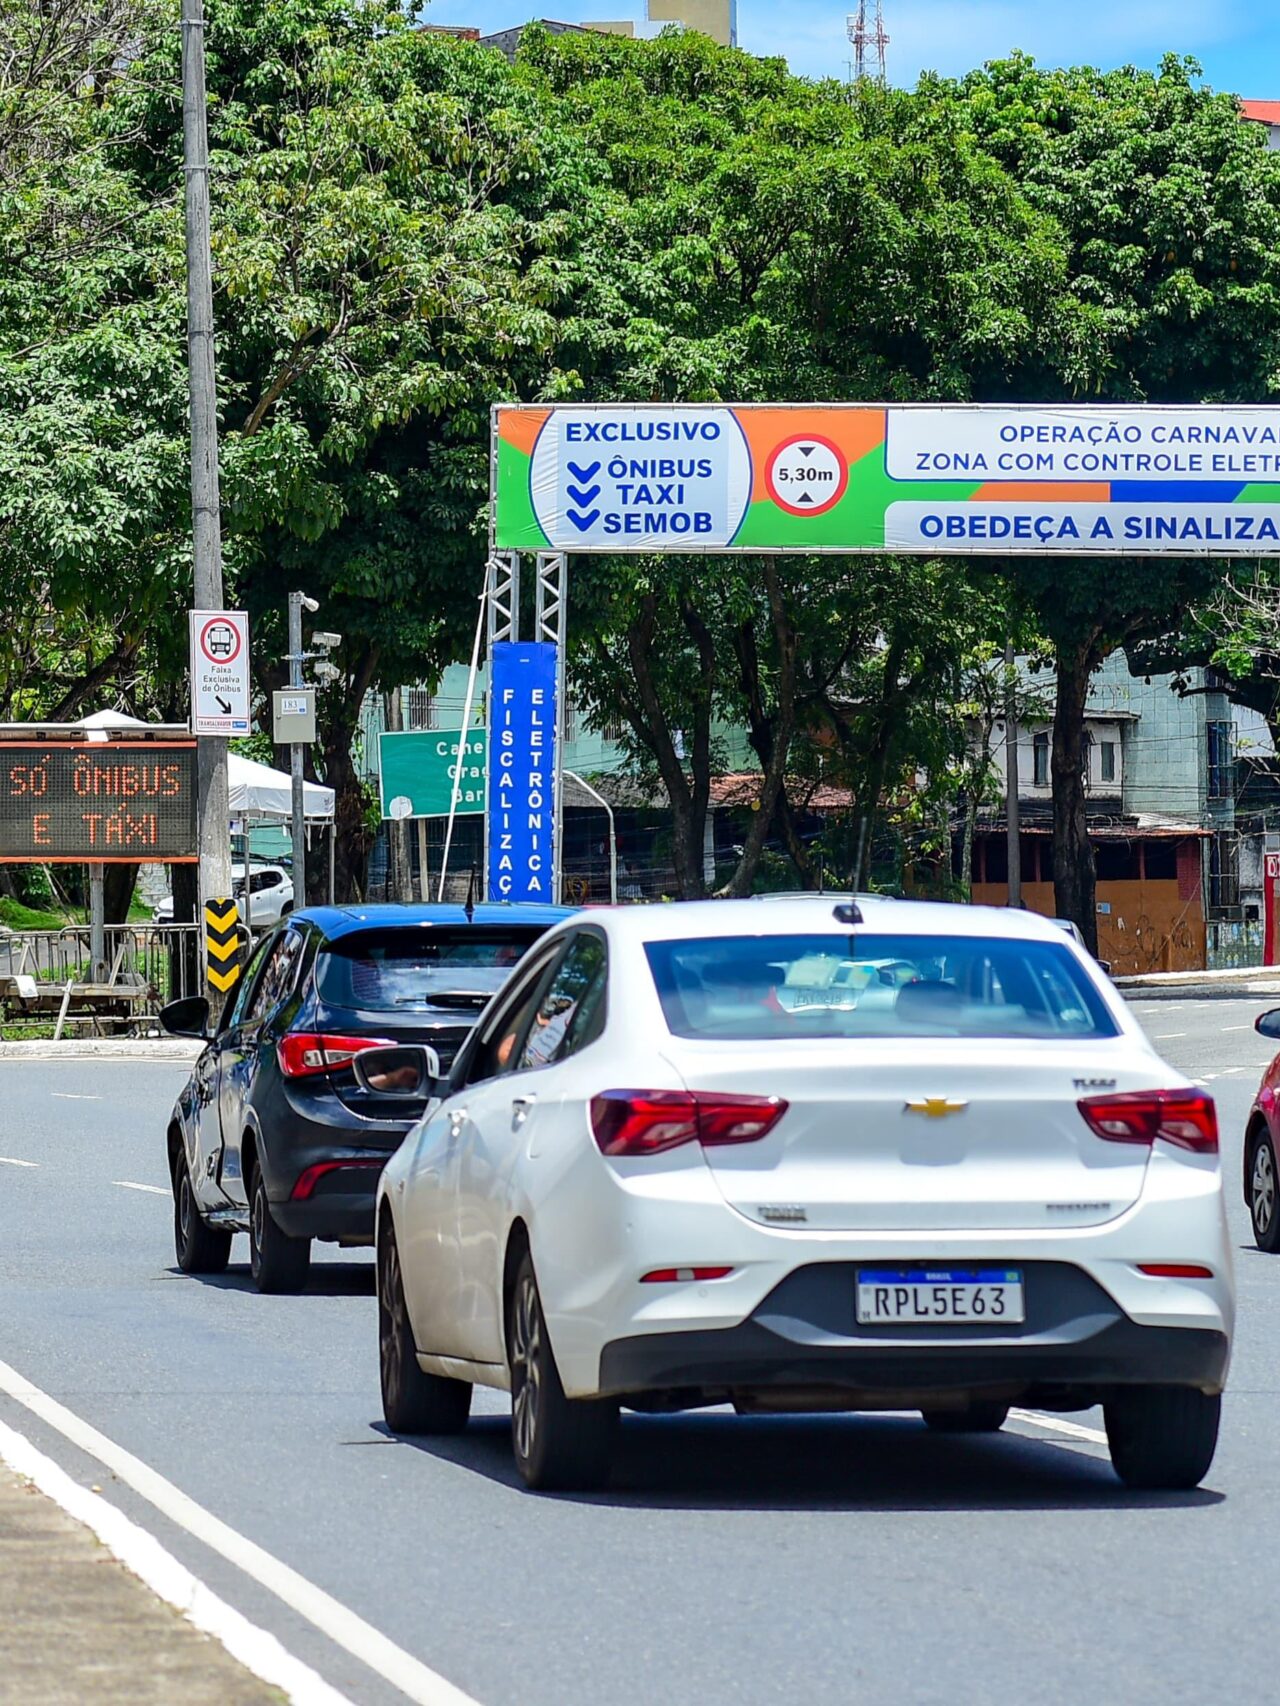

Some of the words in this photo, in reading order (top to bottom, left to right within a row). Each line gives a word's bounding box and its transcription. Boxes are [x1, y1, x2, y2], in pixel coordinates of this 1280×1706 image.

[566, 421, 721, 442] EXCLUSIVO
[999, 422, 1142, 446] OPERAÇÃO
[607, 454, 713, 479] ÔNIBUS
[916, 452, 989, 471] ZONA
[997, 453, 1054, 471] COM
[1063, 453, 1203, 472] CONTROLE
[778, 467, 833, 484] 5,30m
[615, 483, 685, 506] TAXI
[602, 511, 713, 534] SEMOB
[919, 514, 1081, 544] OBEDEÇA
[1089, 517, 1115, 540] A
[203, 674, 240, 684] Exclusiva
[211, 665, 232, 674] Faixa
[202, 684, 211, 692] de
[213, 683, 241, 693] Ônibus
[284, 700, 297, 709] 183
[10, 753, 52, 796] SÓ
[73, 753, 181, 796] ÔNIBUS
[527, 689, 544, 892] ELETRÔNICA
[33, 813, 51, 845] E
[82, 802, 157, 845] TÁXI
[874, 1287, 1006, 1316] RPL5E63
